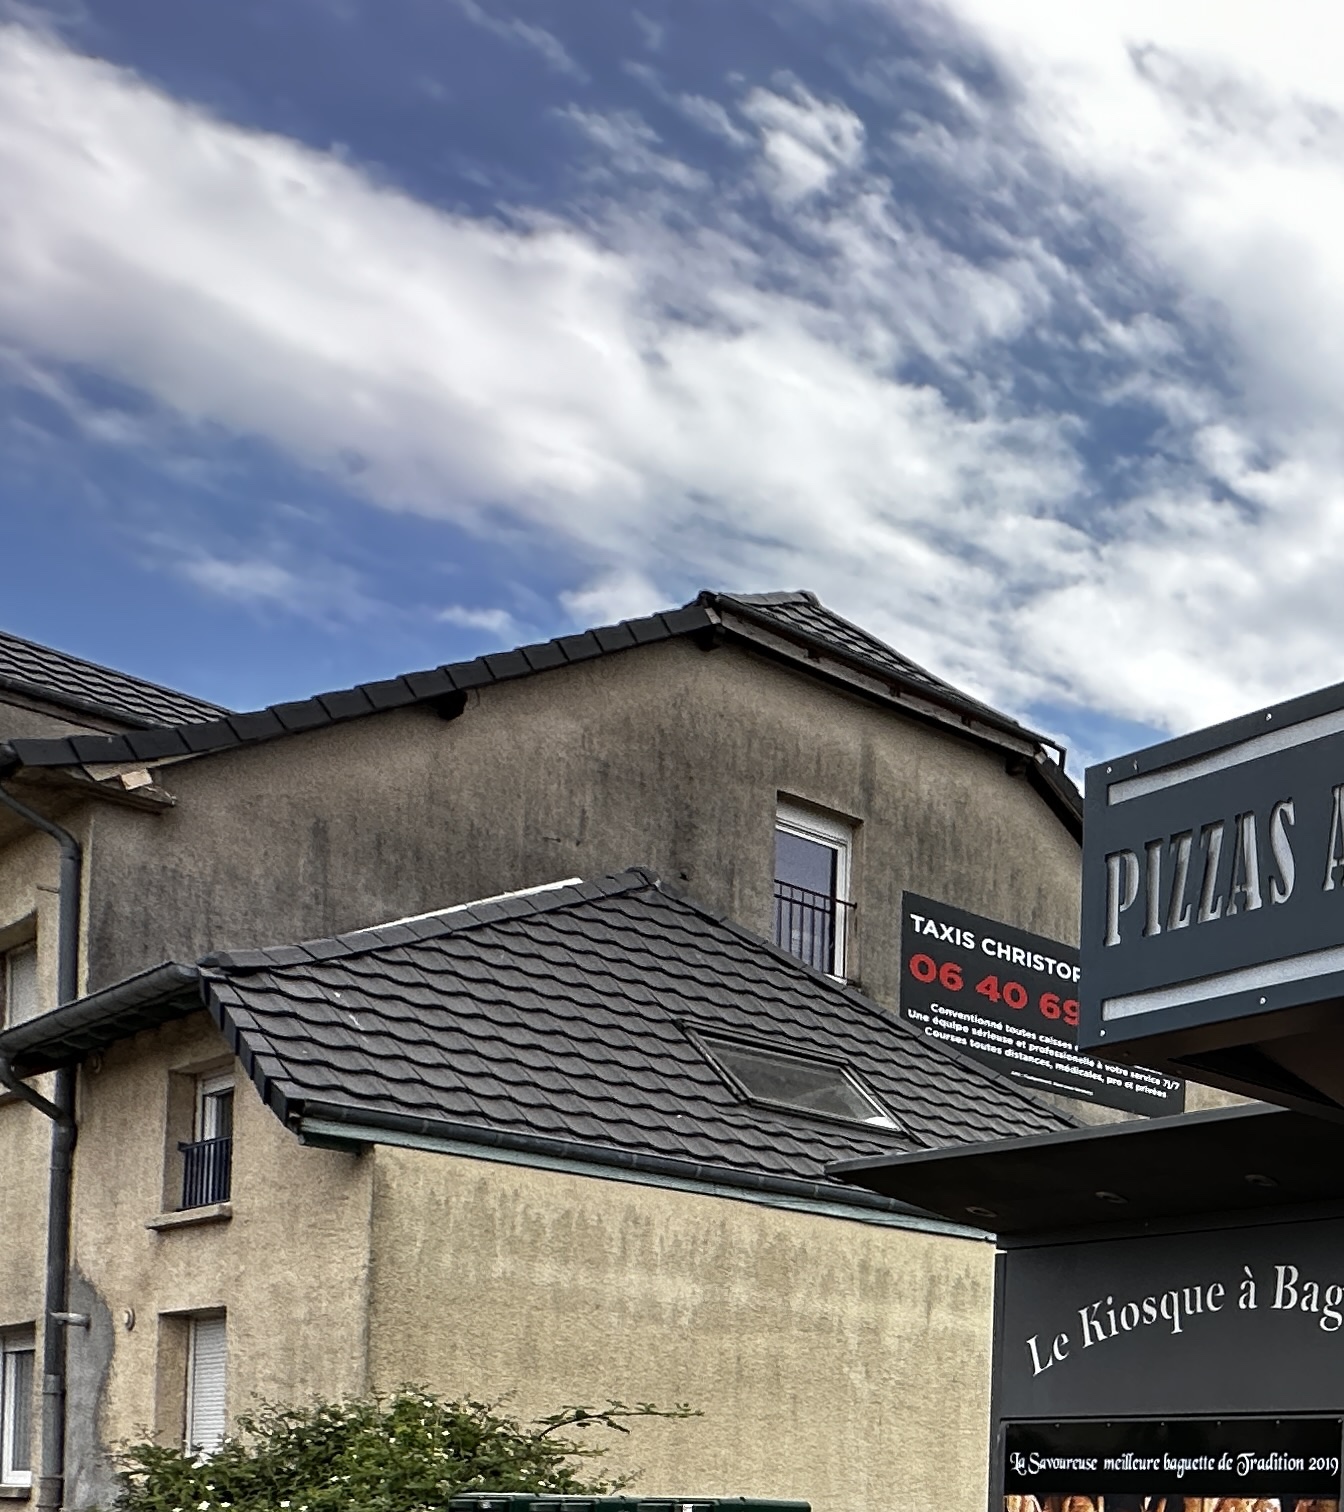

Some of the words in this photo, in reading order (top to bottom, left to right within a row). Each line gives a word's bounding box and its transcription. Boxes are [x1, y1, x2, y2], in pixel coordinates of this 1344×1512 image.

[1103, 797, 1295, 947] PIZZAS
[910, 913, 975, 949] TAXIS
[909, 953, 964, 991] 06
[975, 975, 1029, 1010] 40
[1039, 992, 1080, 1026] 69
[907, 1008, 930, 1023] Une
[932, 1016, 969, 1033] équipe
[971, 1027, 1014, 1045] sérieuse
[1016, 1040, 1027, 1049] et
[1105, 1064, 1128, 1077] votre
[1130, 1071, 1160, 1085] service
[925, 1026, 968, 1045] Courses
[969, 1039, 1002, 1055] toutes
[1004, 1048, 1053, 1069] distances,
[1107, 1076, 1122, 1087] pro
[1005, 1024, 1037, 1040] toutes
[1025, 1333, 1070, 1377] Le
[1078, 1279, 1225, 1349] Kiosque
[1238, 1266, 1257, 1310] à
[1028, 1452, 1098, 1475] Savoureuse
[1103, 1453, 1160, 1471] meilleure
[1163, 1453, 1215, 1478] baguette
[1217, 1453, 1233, 1471] de
[1236, 1453, 1304, 1476] Tradition
[1308, 1457, 1339, 1476] 2019
